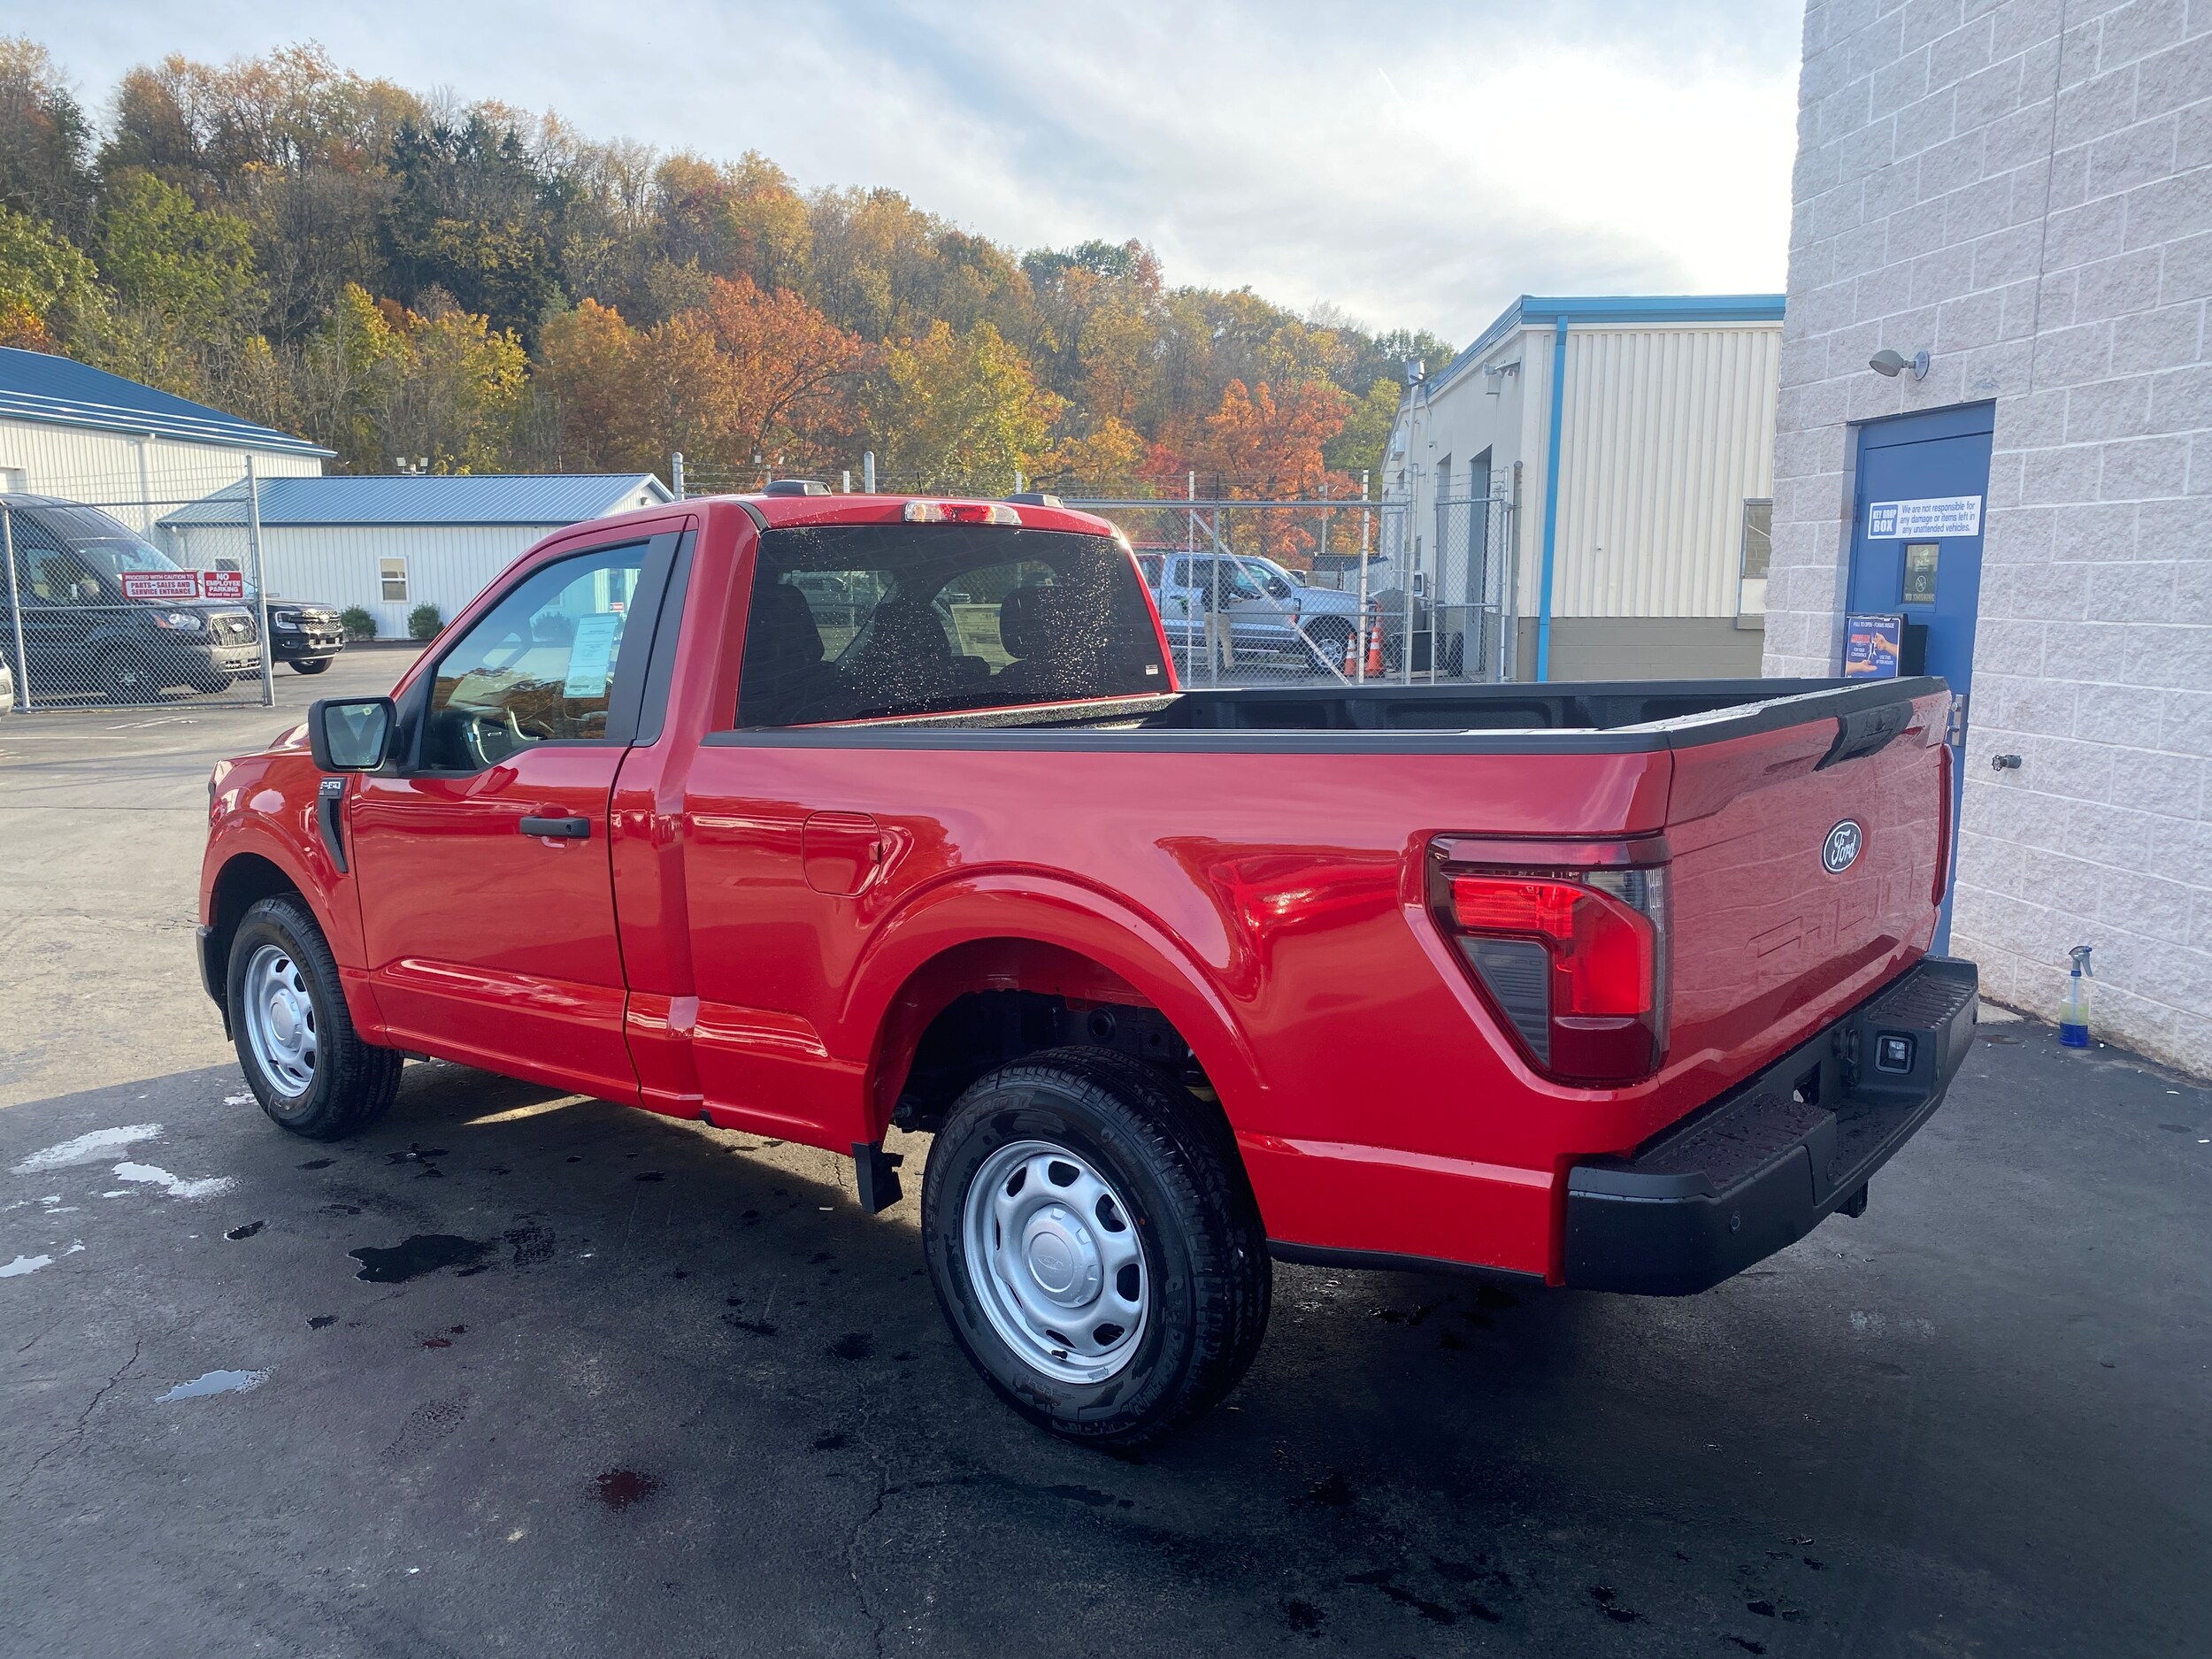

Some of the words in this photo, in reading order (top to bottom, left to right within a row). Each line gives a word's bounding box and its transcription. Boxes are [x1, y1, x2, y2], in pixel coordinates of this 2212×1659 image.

[1872, 511, 1882, 519] KEY
[1882, 509, 1896, 519] DROP
[1901, 504, 1911, 513] We
[1932, 502, 1965, 514] responsible
[1966, 501, 1976, 510] for
[1900, 516, 1909, 526] any
[1910, 515, 1933, 525] damage
[1940, 513, 1957, 522] items
[1958, 512, 1969, 521] left
[1873, 519, 1893, 533] BOX
[1901, 526, 1912, 535] any
[1913, 525, 1944, 534] unattended
[1831, 829, 1857, 866] Ford
[1485, 956, 1542, 967] FORD
